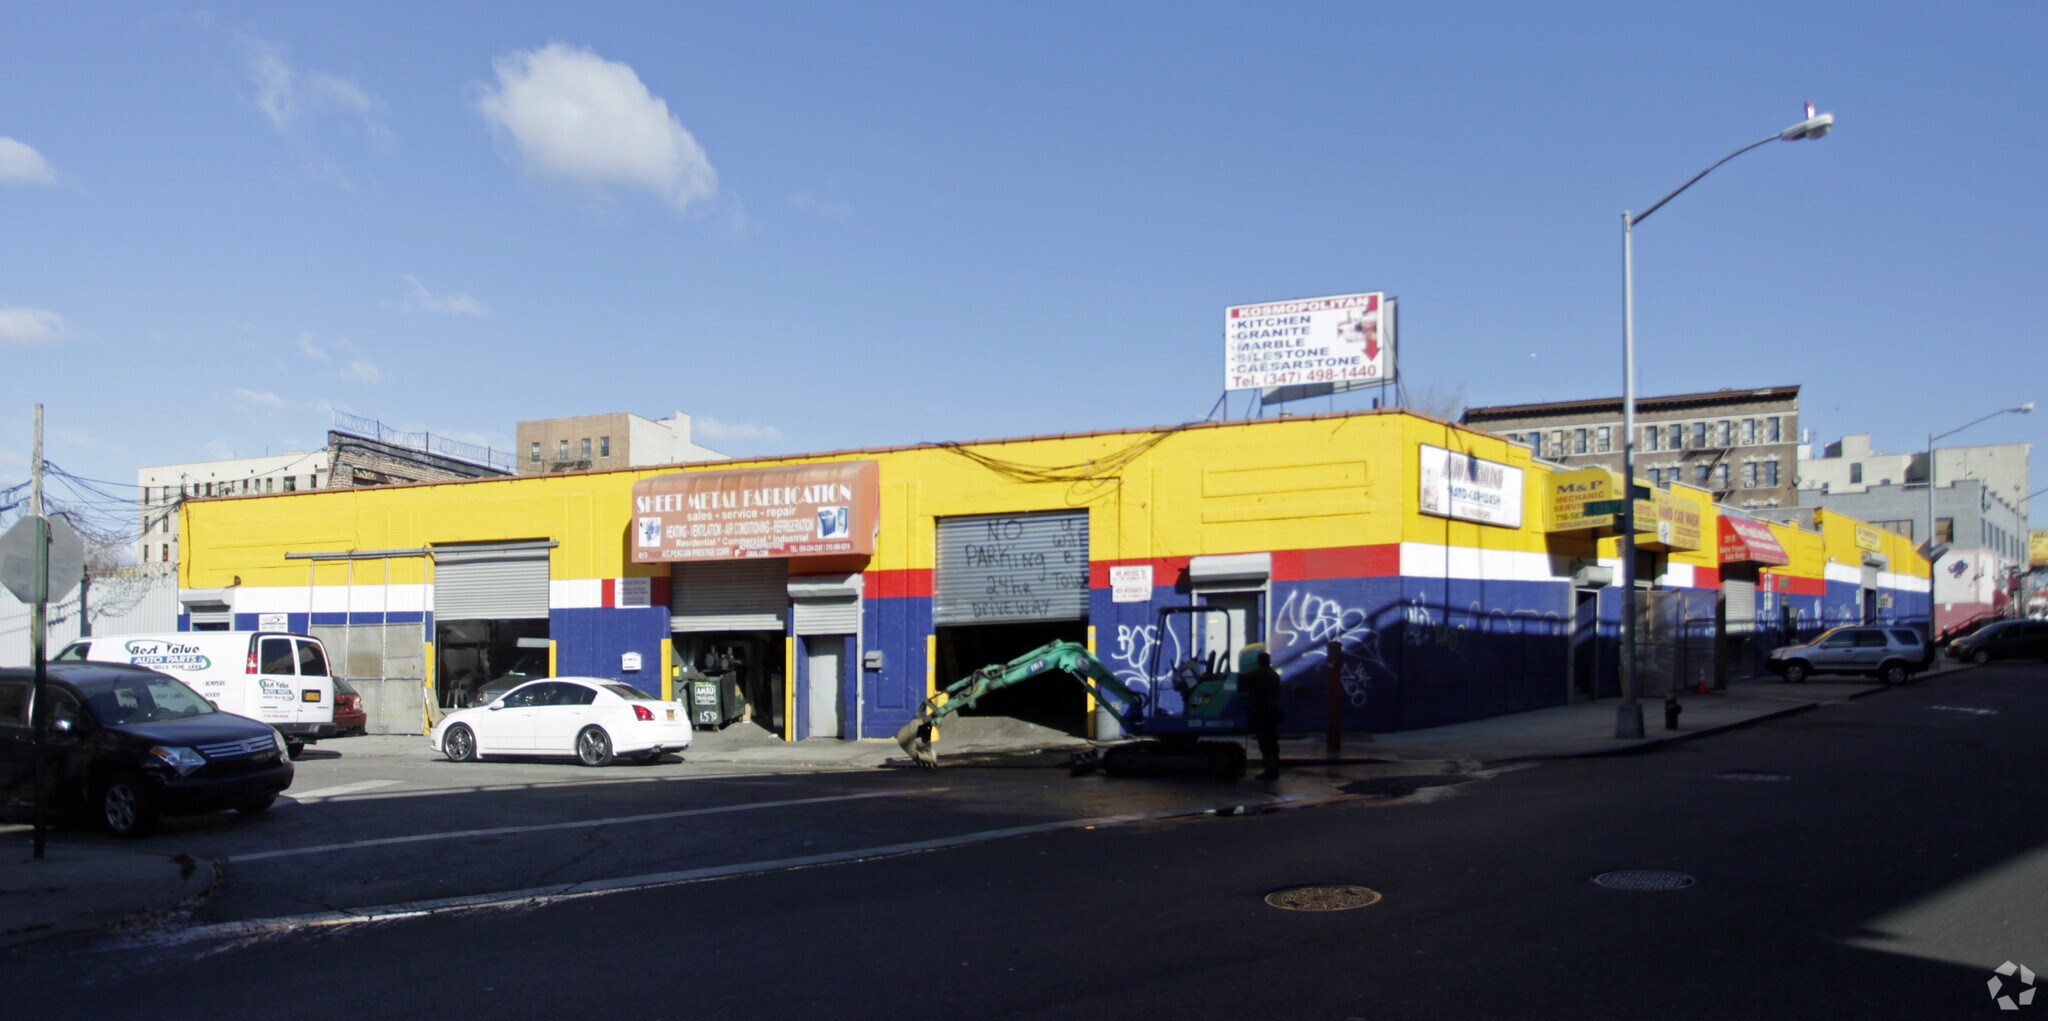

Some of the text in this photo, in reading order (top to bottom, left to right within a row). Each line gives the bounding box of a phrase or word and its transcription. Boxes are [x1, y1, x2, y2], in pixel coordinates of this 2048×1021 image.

[1238, 296, 1369, 318] KOSMOPOLITAN
[1237, 315, 1311, 329] KITCHEN
[1237, 326, 1311, 340] GRANITE
[1237, 338, 1305, 351] MARBLE
[1237, 347, 1330, 362] SILESTONE
[1236, 356, 1361, 373] CAESARSTONE
[1233, 365, 1376, 388] Tel. (347) 498-1440
[636, 483, 852, 514] SHEET METAL FABRICATION
[1555, 490, 1605, 503] MECHANIC
[687, 506, 797, 522] sales service repair
[665, 518, 814, 538] HEATING VENTILATION AIR CONDITIONING REFRIGERATION
[987, 517, 1023, 541] NO
[675, 533, 809, 547] Residential Commercial Industrial
[131, 643, 200, 655] Best Value
[134, 656, 163, 664] AUTO
[166, 655, 197, 664] PARTS
